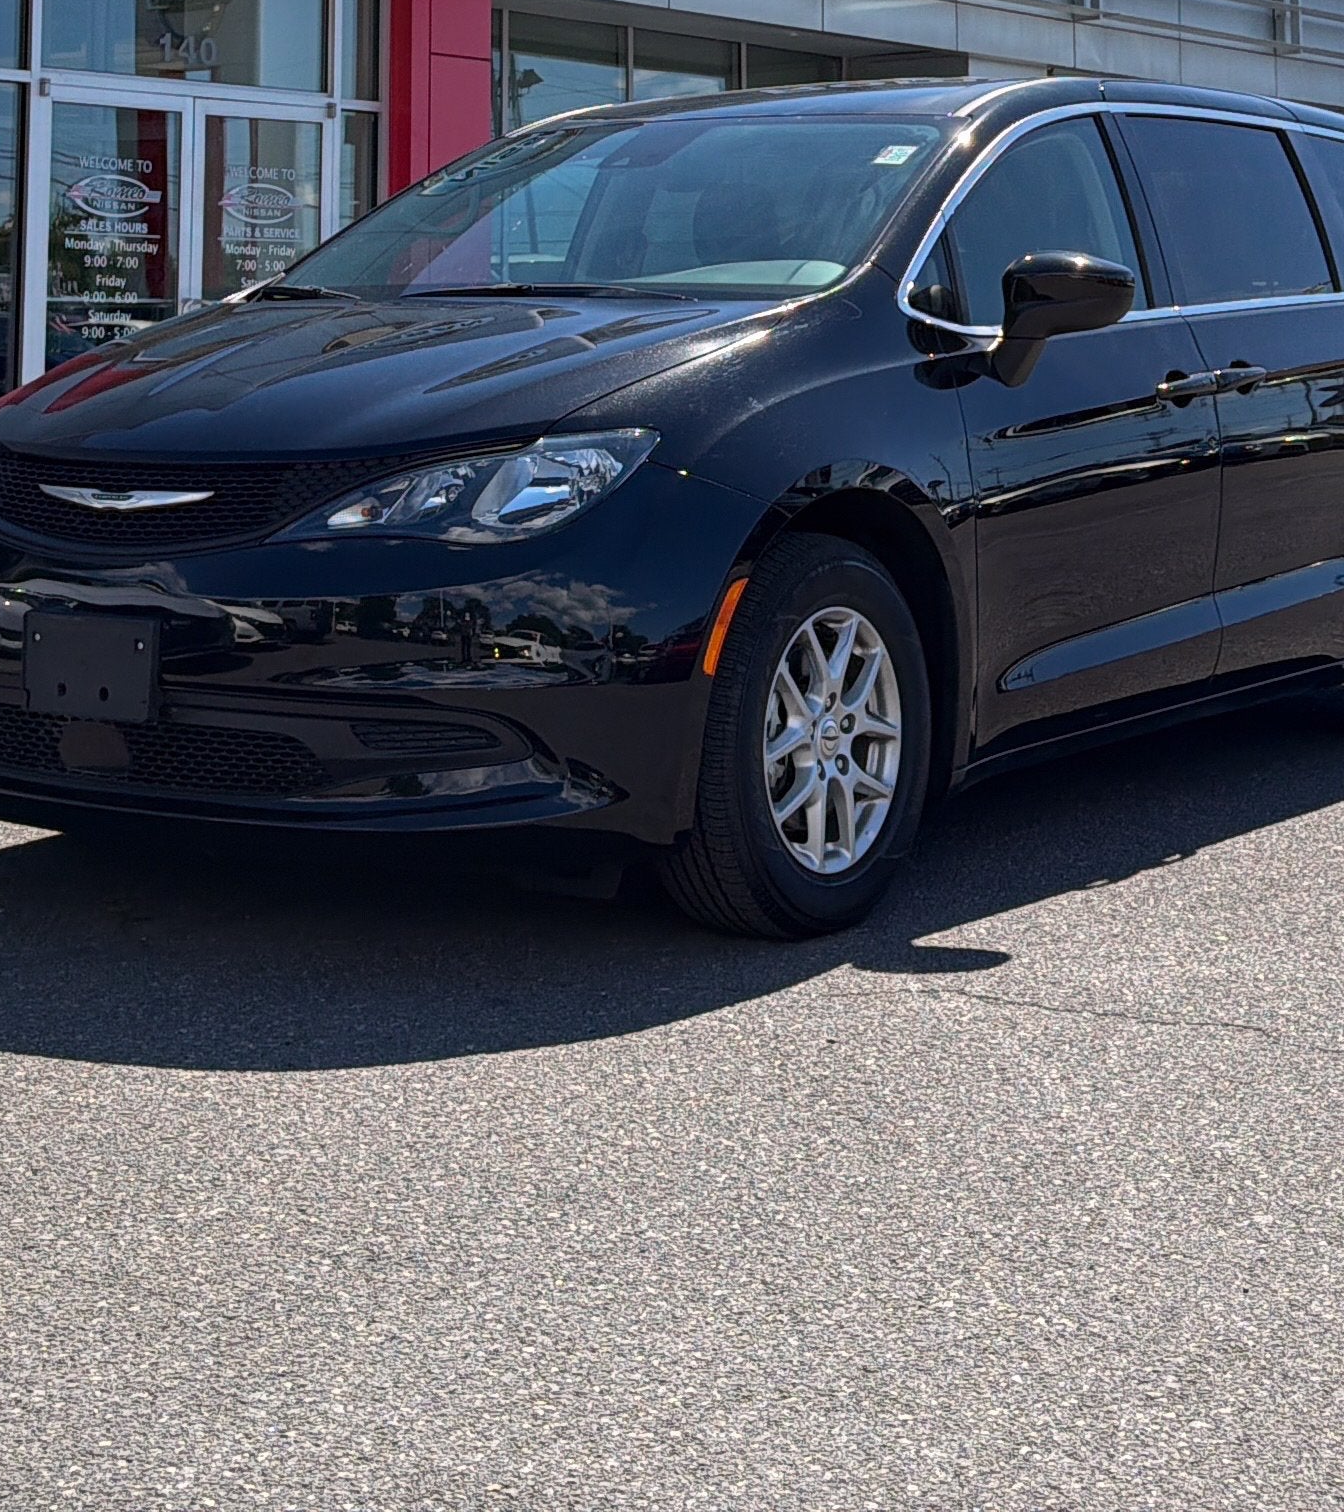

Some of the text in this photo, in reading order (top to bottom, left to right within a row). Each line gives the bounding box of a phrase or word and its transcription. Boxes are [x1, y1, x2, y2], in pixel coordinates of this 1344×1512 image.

[159, 32, 218, 67] 140
[79, 156, 153, 173] WELCOME TO
[229, 166, 296, 180] WELCOME TO
[86, 177, 146, 200] Romeo
[92, 199, 136, 210] NISSAN
[242, 208, 281, 217] NISSAN
[80, 219, 148, 234] SALES HOURS
[224, 227, 300, 239] PARTS & SERVICE
[64, 237, 105, 252] Monday
[113, 239, 159, 256] Thursday
[225, 243, 262, 258] Monday
[268, 245, 296, 258] Friday
[84, 255, 107, 268] 9:00
[116, 256, 139, 269] 7:00
[236, 259, 257, 271] 7:00
[265, 260, 286, 272] 5:00
[95, 274, 127, 289] Friday
[83, 291, 106, 303] 9:00
[114, 291, 138, 304] 6:00
[88, 309, 132, 325] Saturday
[81, 326, 105, 339] 9:00
